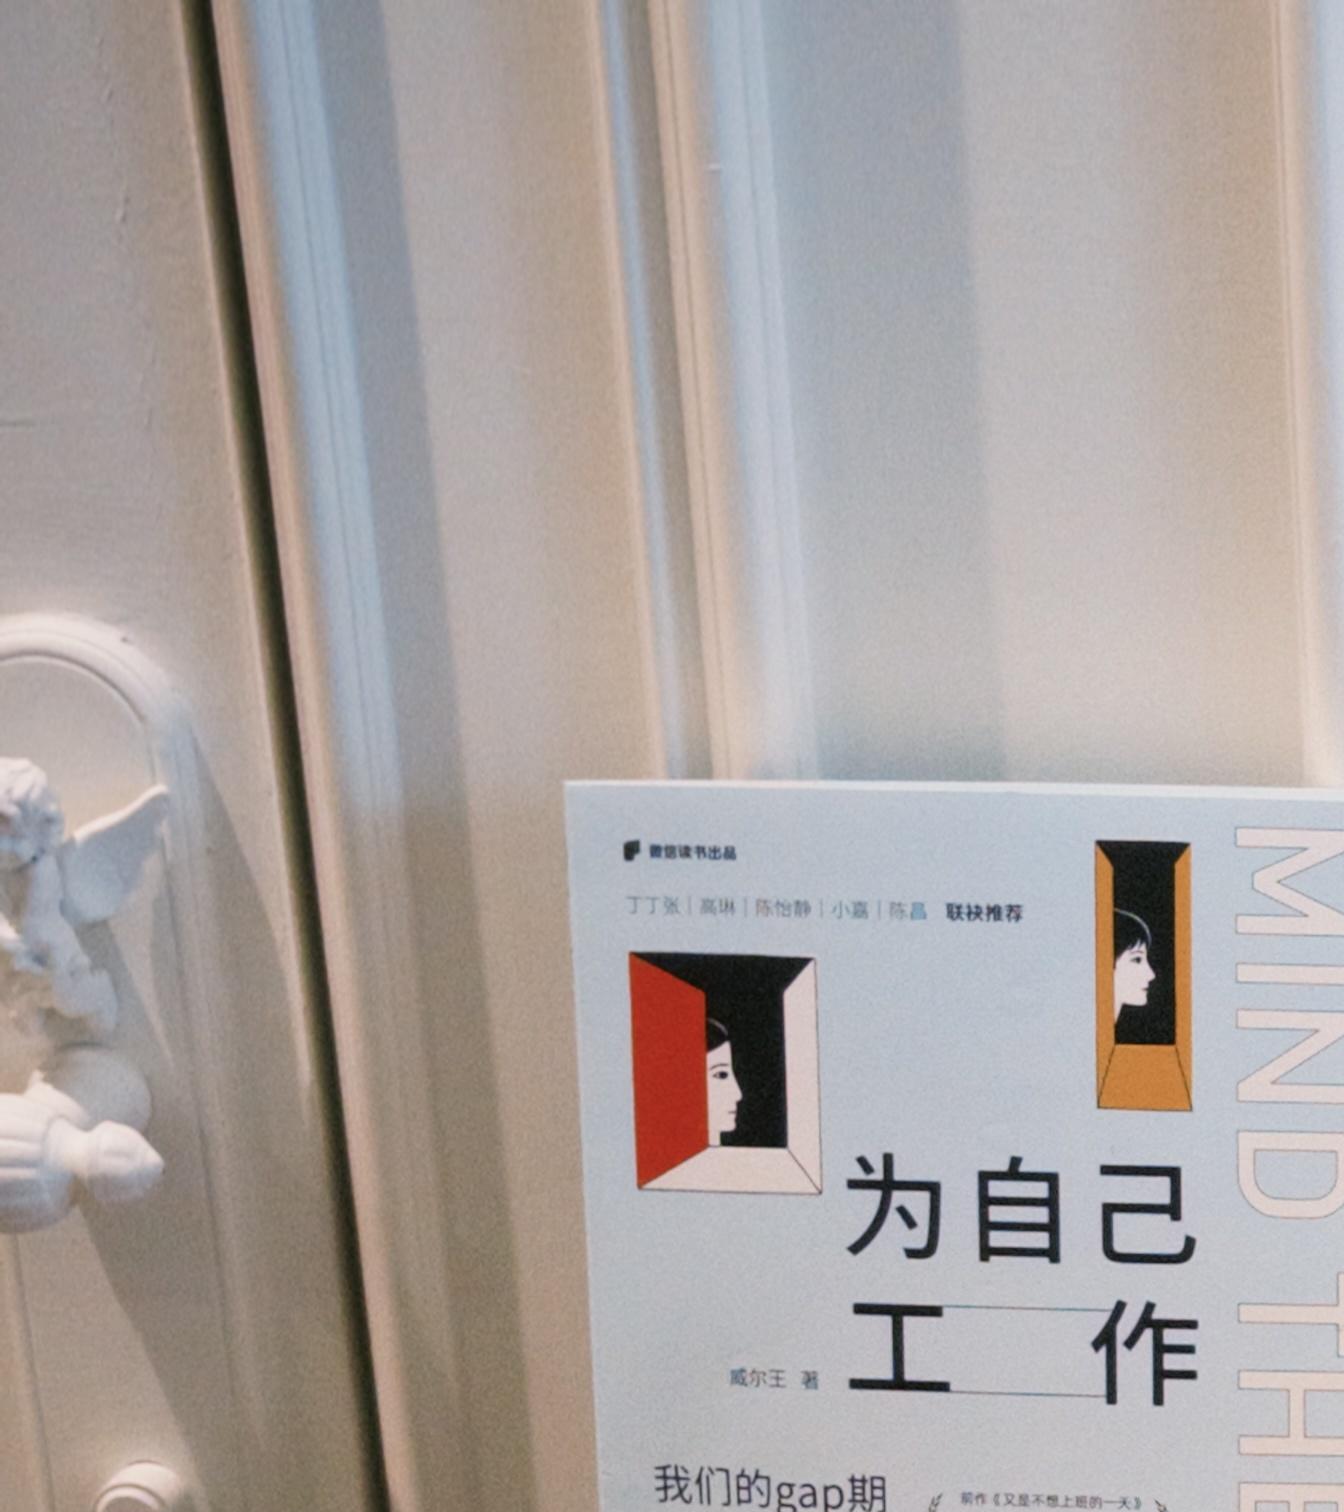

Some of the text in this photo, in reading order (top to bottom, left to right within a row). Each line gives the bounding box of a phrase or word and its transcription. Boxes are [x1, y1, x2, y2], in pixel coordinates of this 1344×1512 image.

[946, 902, 1023, 923] 联袂推荐
[846, 1152, 1197, 1264] 为自己
[730, 1368, 786, 1389] 威尔王
